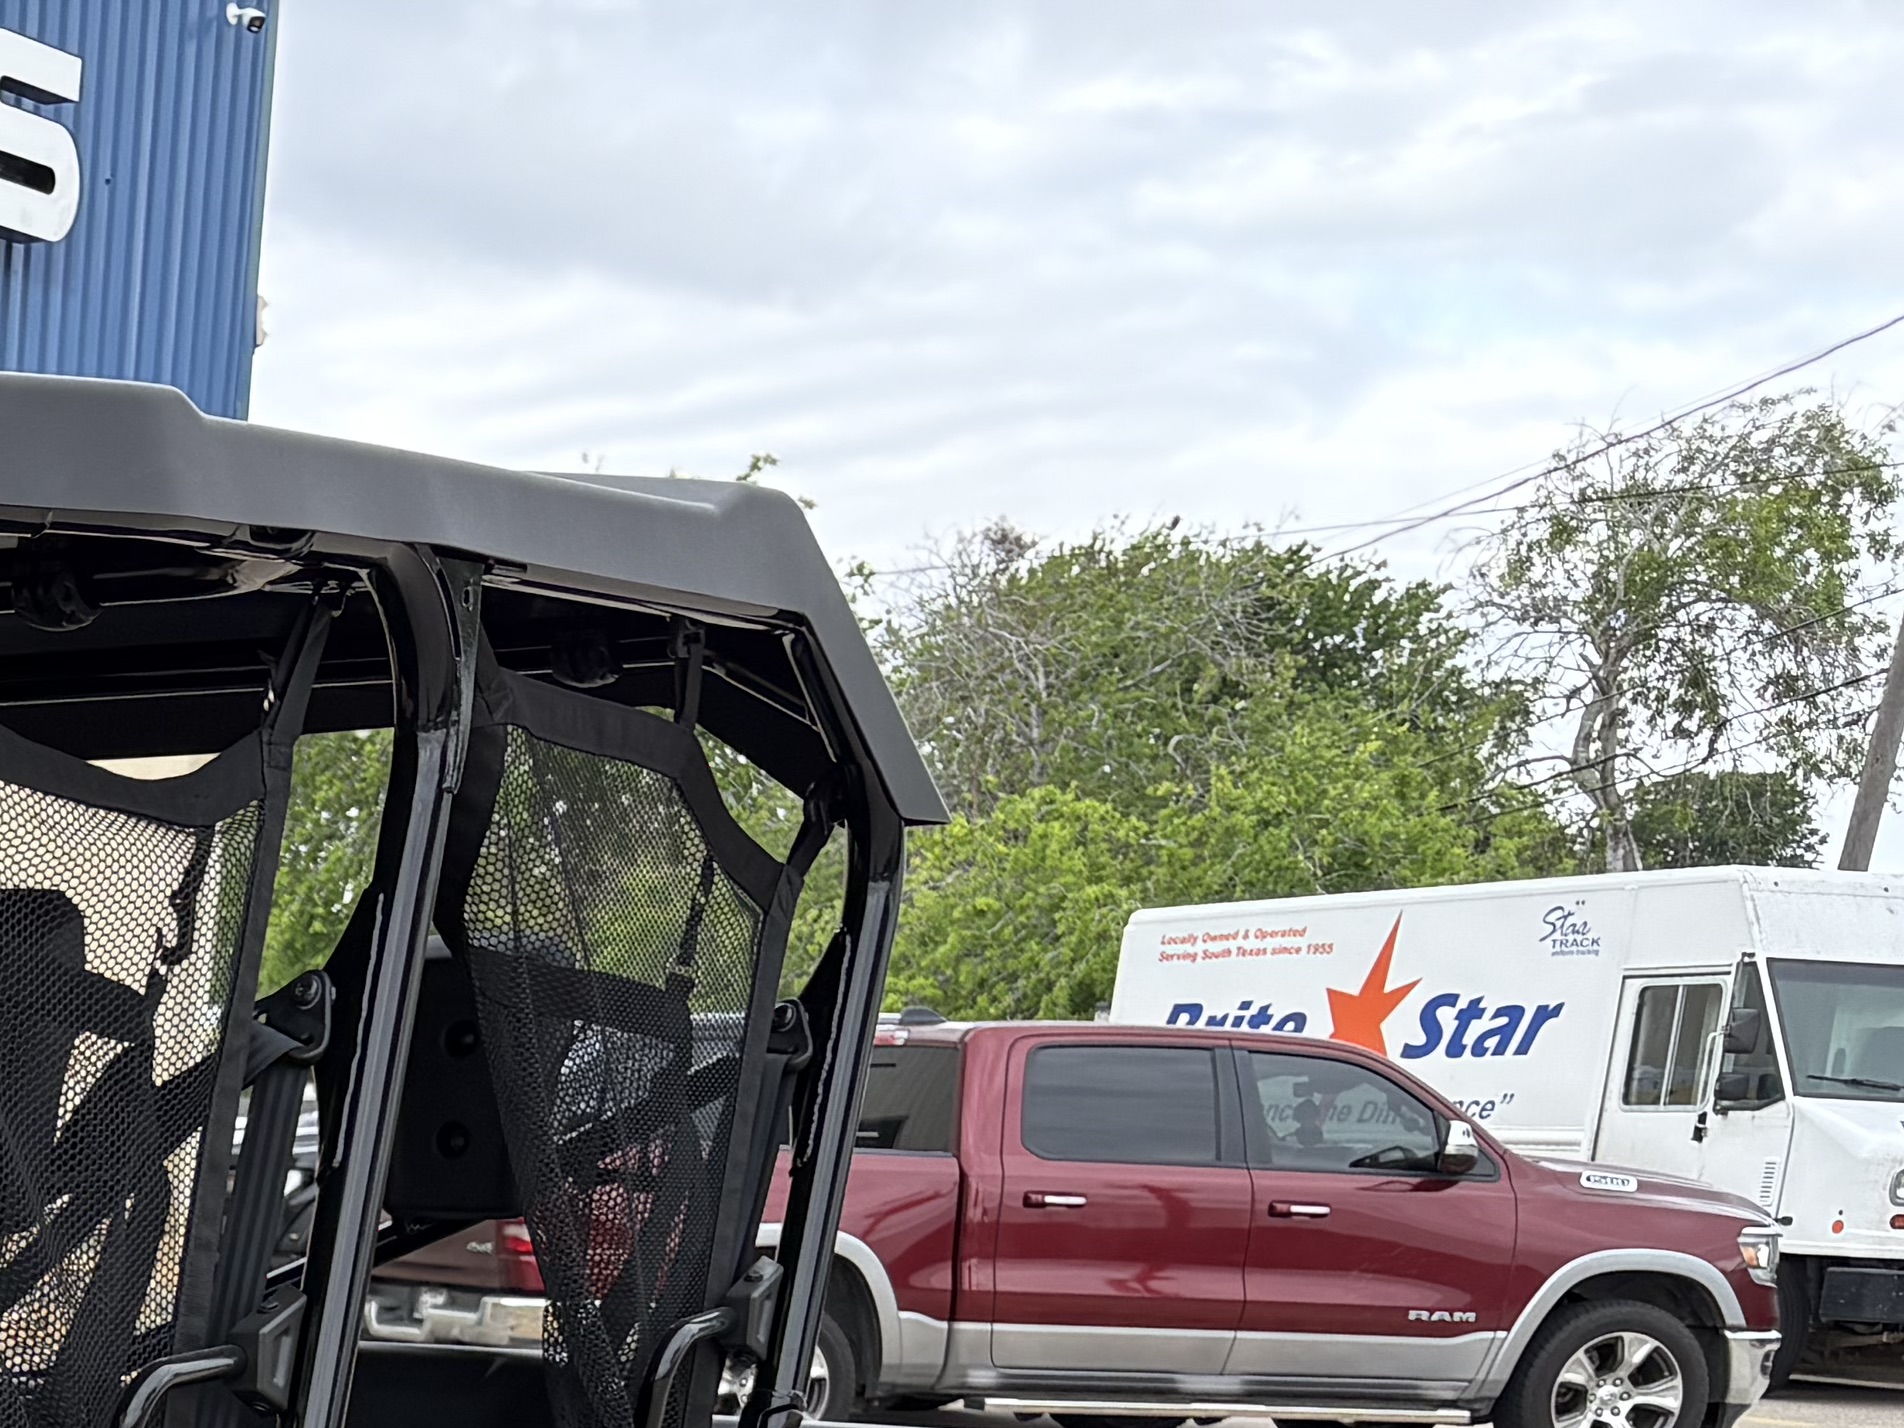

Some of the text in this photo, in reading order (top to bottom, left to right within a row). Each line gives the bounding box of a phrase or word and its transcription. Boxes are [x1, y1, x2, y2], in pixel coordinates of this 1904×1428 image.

[1161, 926, 1308, 947] Locally Owned & Operated
[1551, 937, 1600, 949] TRACK
[1159, 943, 1334, 963] Serving South Texas since 1955
[1400, 993, 1564, 1060] Star
[1408, 1310, 1477, 1323] RAM
